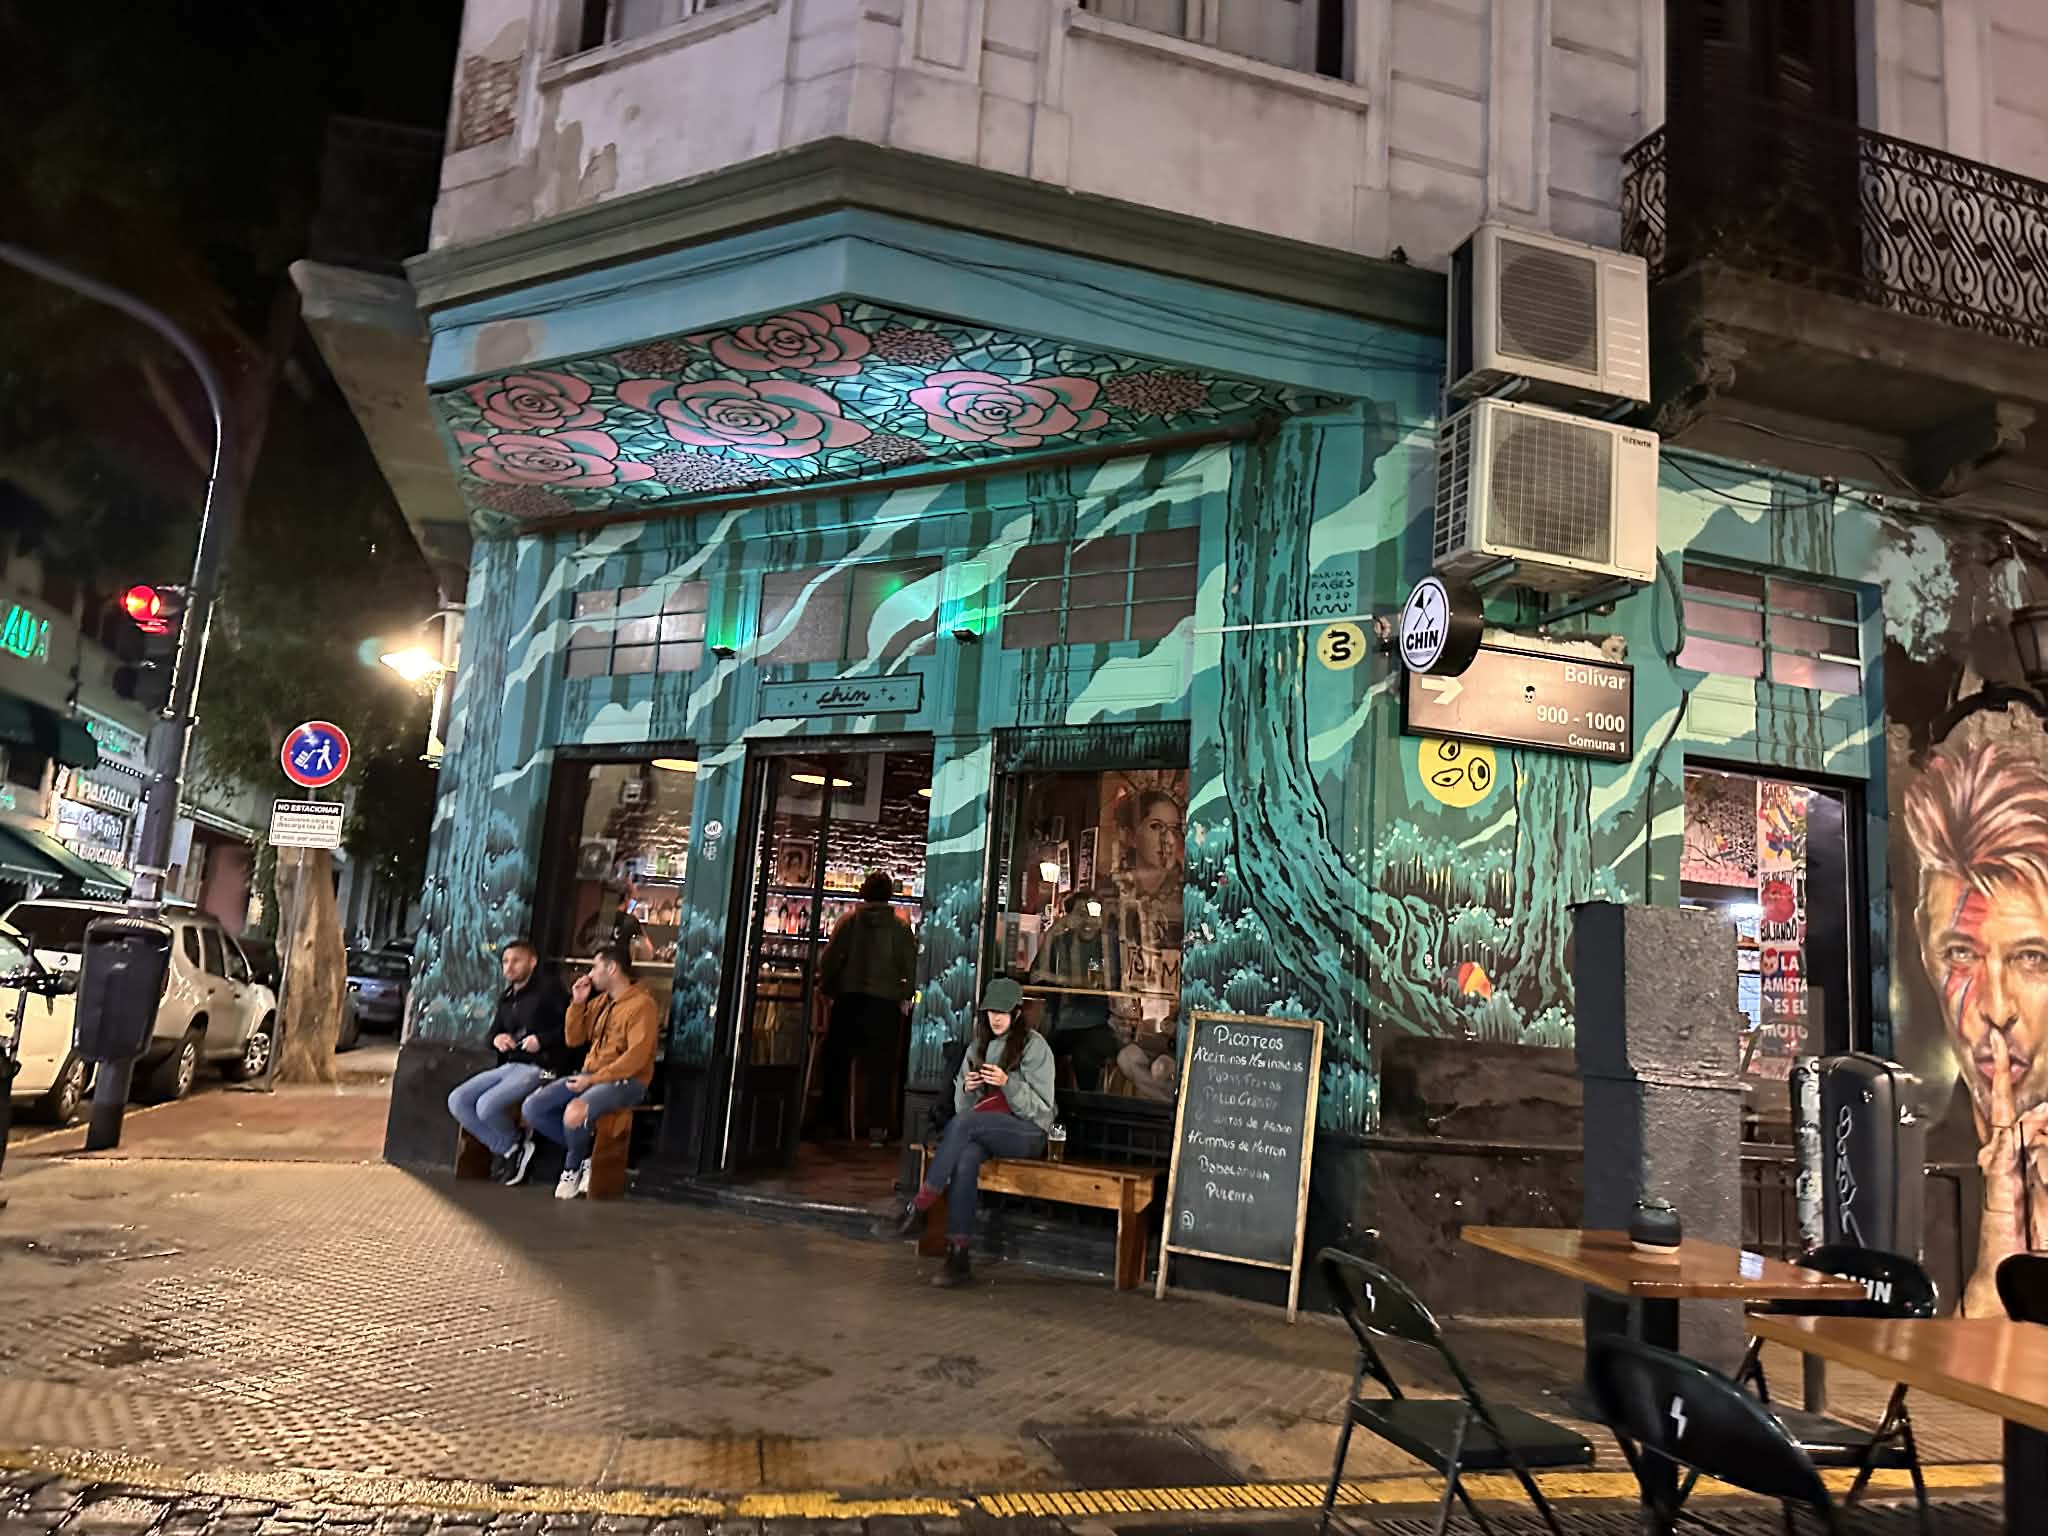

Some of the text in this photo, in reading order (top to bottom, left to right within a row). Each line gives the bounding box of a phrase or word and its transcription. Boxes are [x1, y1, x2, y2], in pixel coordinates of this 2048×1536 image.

[1406, 629, 1439, 651] CHIN
[1565, 665, 1625, 690] Bolívar
[1537, 705, 1568, 724] 900
[1585, 711, 1625, 733] 1000
[1568, 733, 1625, 753] Comuna 1
[81, 781, 139, 814] PARRILLA
[277, 804, 339, 814] NO ESTACIONAR
[1780, 955, 1799, 971] LA
[1773, 998, 1808, 1014] ES EL
[1238, 1140, 1249, 1152] de
